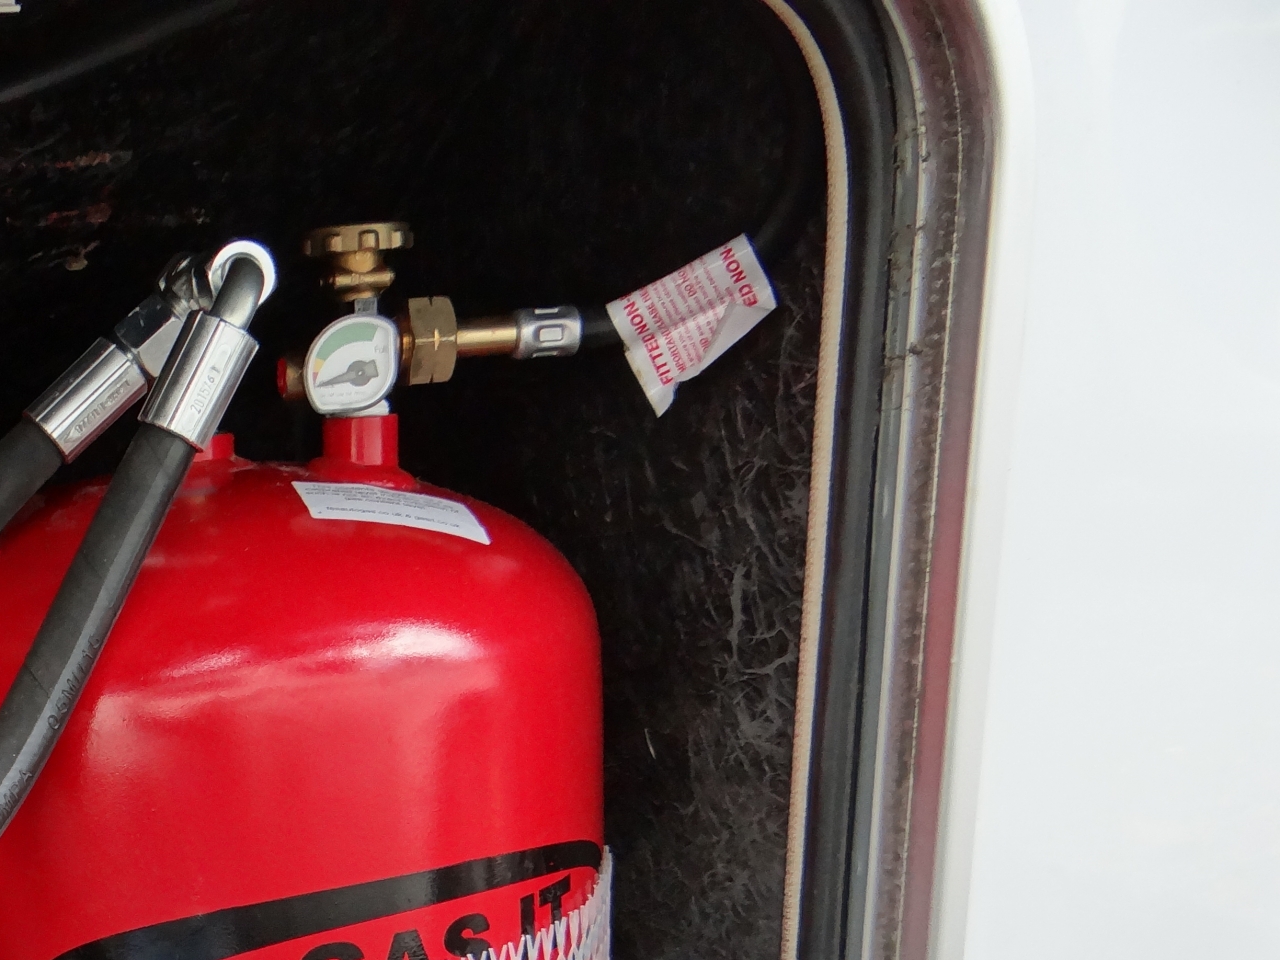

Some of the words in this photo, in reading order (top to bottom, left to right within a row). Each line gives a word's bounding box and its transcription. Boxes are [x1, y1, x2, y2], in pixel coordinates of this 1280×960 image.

[677, 270, 689, 283] NO
[641, 330, 673, 385] FITTED
[661, 328, 687, 373] MPORTANT
